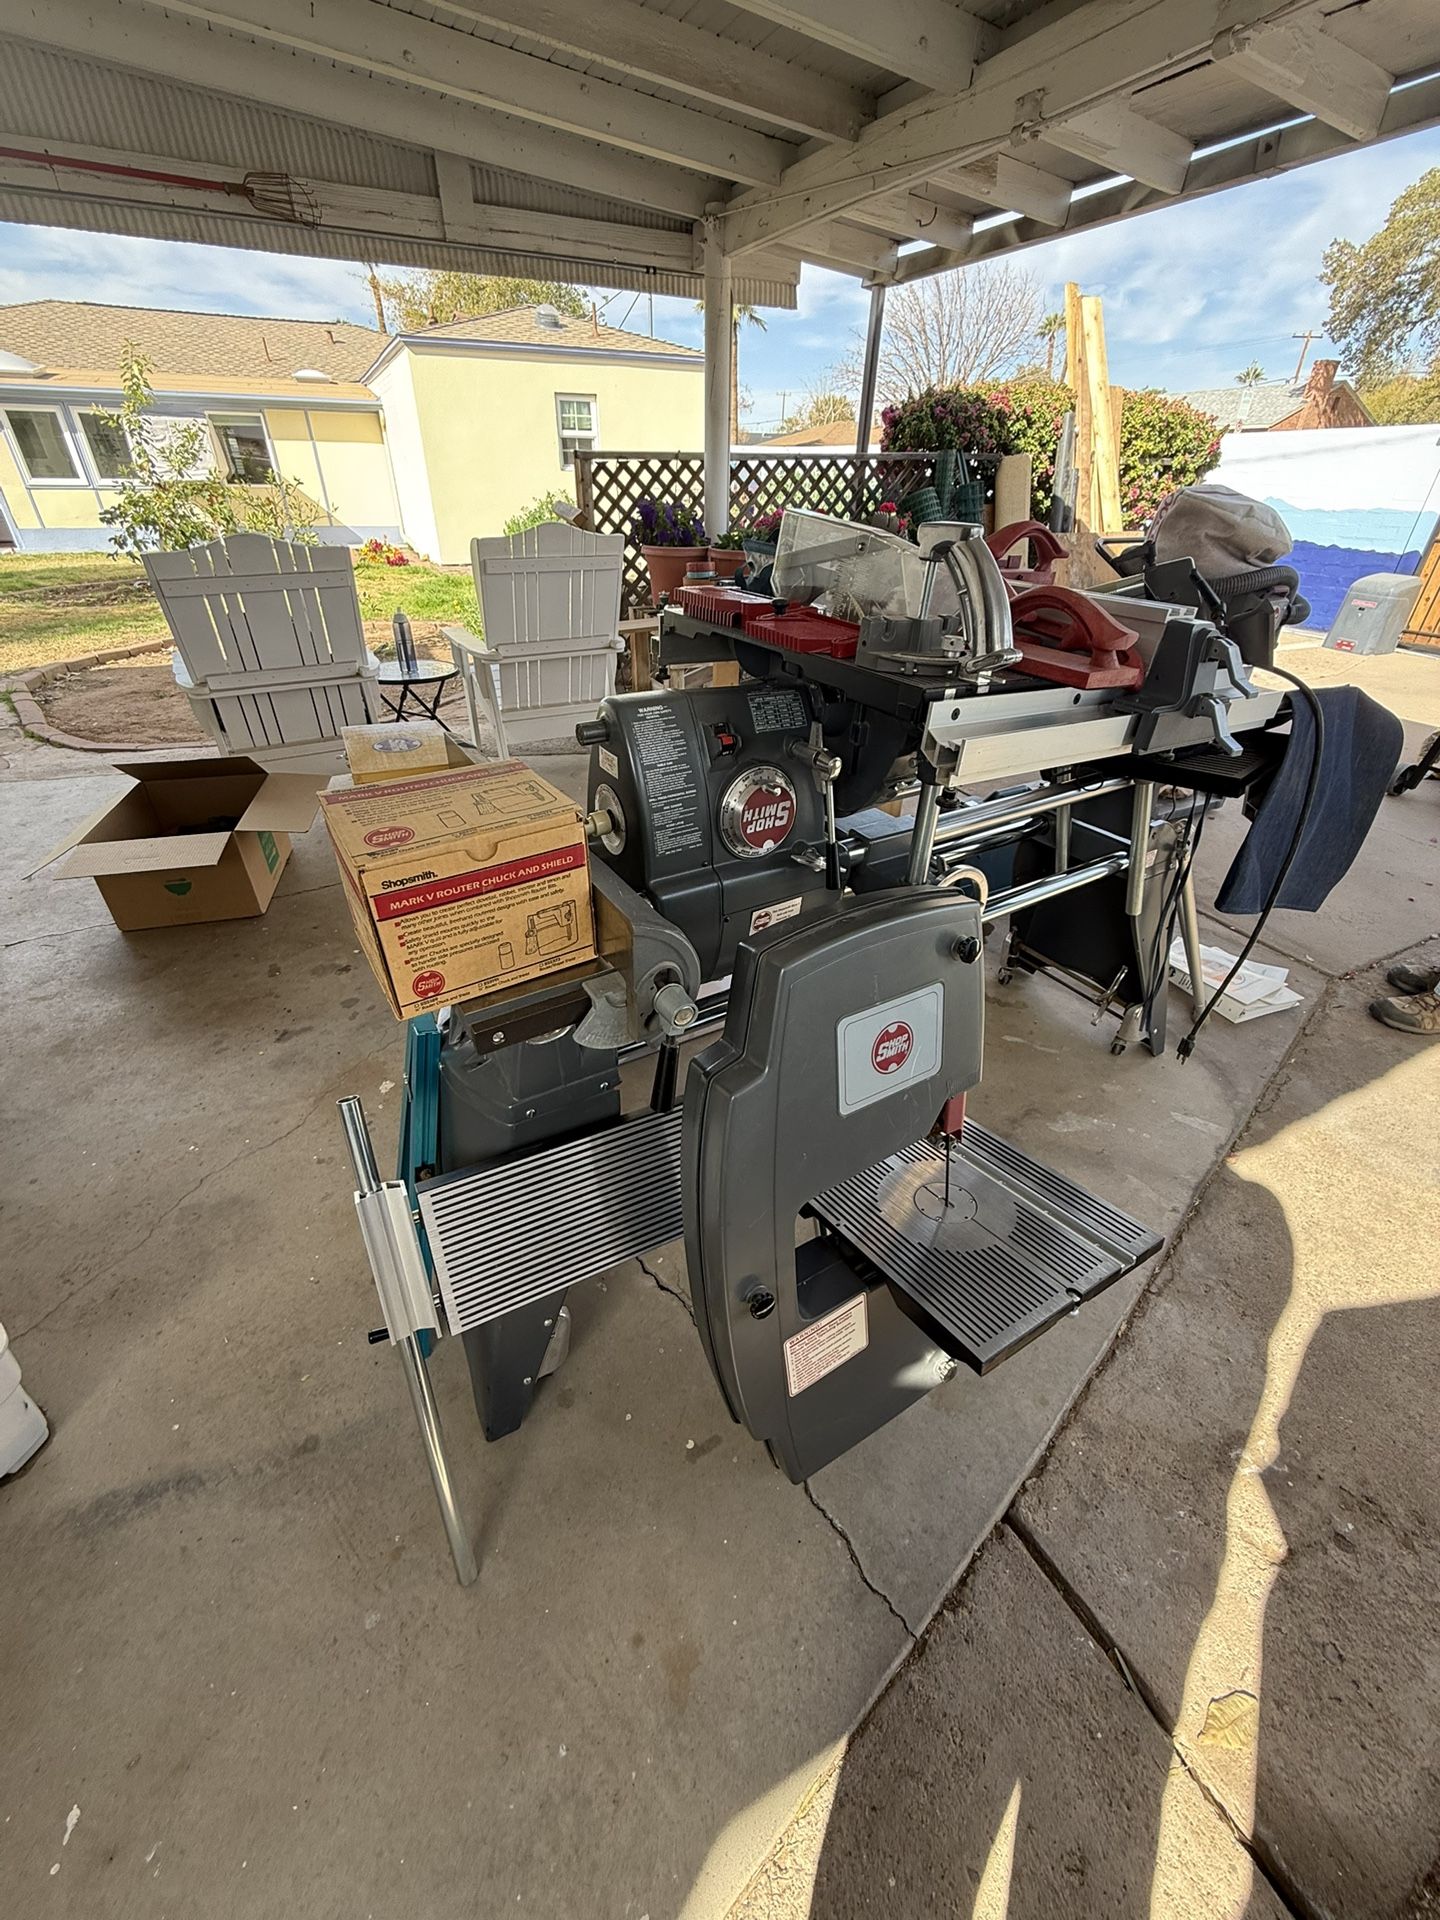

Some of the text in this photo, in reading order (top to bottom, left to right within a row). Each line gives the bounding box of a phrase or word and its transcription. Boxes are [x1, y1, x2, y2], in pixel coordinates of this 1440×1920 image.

[390, 855, 574, 911] MARK V ROUTER CHUCK AND SHIELD
[400, 915, 419, 923] Allows
[456, 900, 475, 909] perfect
[403, 928, 421, 937] Create
[449, 914, 472, 924] freehand
[496, 902, 515, 911] designs
[433, 914, 448, 922] joints
[466, 901, 491, 912] combined
[422, 930, 438, 939] Shield
[460, 920, 478, 928] quickly
[406, 941, 423, 949] MARK
[409, 954, 427, 962] Router
[429, 947, 448, 956] Chucks
[459, 938, 480, 947] specially
[481, 930, 503, 941] designed
[418, 957, 436, 965] handle
[449, 946, 473, 957] pressures
